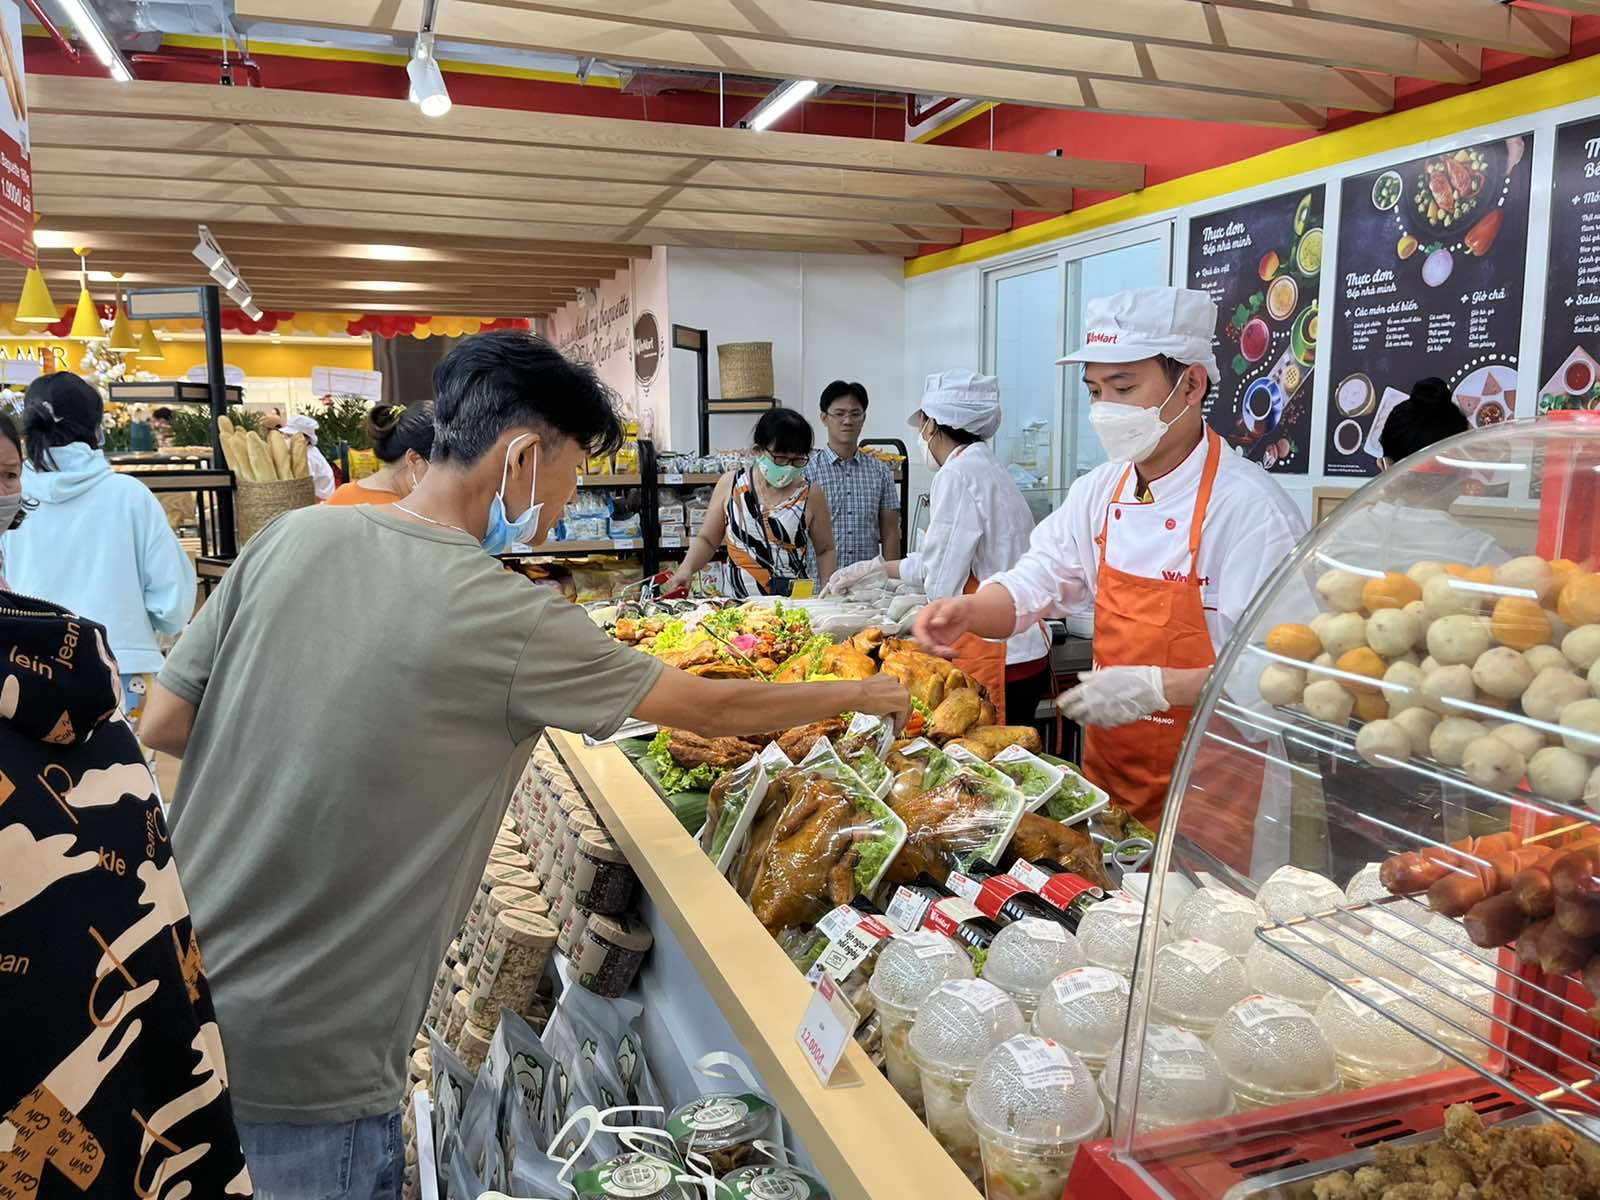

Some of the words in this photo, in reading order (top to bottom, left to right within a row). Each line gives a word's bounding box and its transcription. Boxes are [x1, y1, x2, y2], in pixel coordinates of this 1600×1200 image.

[1202, 226, 1225, 242] Thực
[1226, 221, 1246, 237] đơn
[1202, 241, 1216, 256] Bếp
[1346, 272, 1372, 288] Thực
[1372, 268, 1394, 283] đơn
[1346, 287, 1360, 300] Bếp
[1360, 285, 1376, 296] nhà
[1354, 306, 1368, 318] Các
[1368, 304, 1386, 316] món
[1386, 300, 1401, 314] chế
